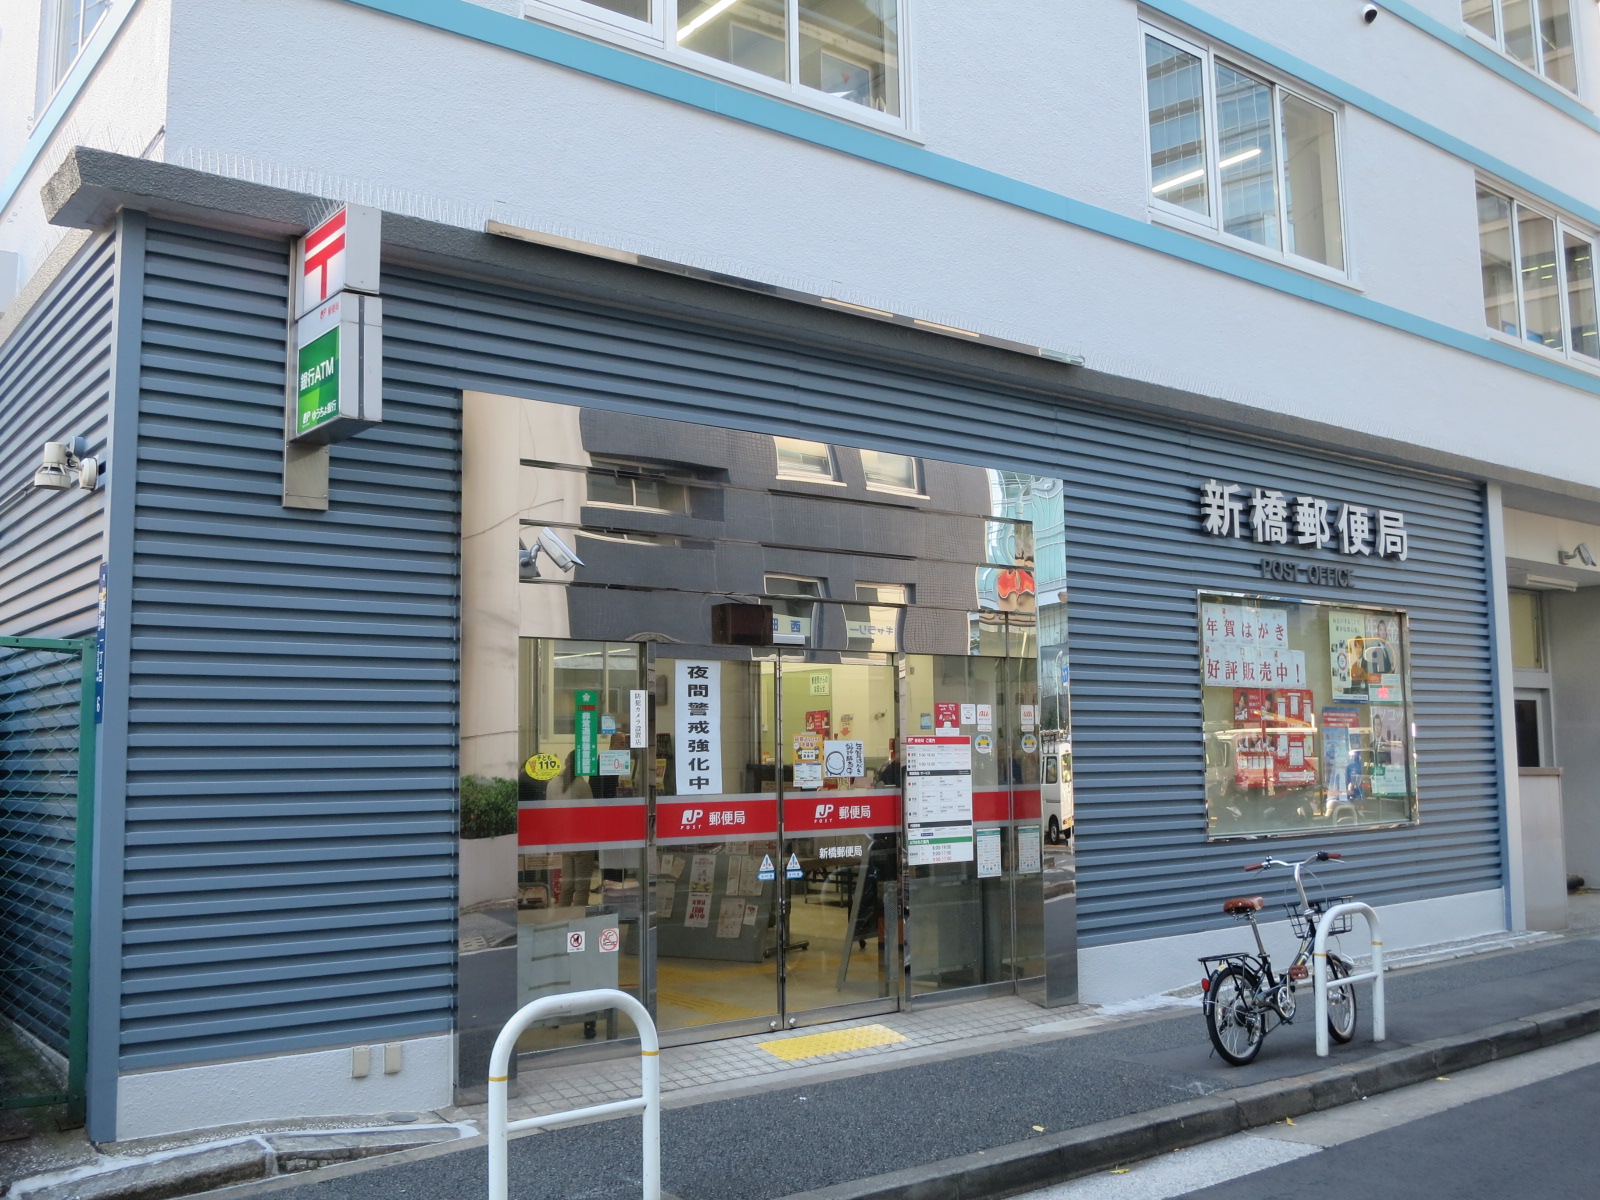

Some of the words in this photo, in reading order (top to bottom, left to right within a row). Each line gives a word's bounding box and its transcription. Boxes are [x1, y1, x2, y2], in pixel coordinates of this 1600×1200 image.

[300, 356, 334, 391] 銀行ATM
[312, 400, 337, 422] ゆうちょ銀行
[1200, 479, 1408, 562] 新橋郵便局
[1261, 558, 1300, 582] POST
[1307, 565, 1355, 588] OFFICE
[1205, 617, 1285, 642] 年賀はがき
[1207, 659, 1300, 684] 好評販売中！
[634, 692, 642, 746] 防犯カメラ設置店
[687, 665, 710, 790] 夜間警戒強化中
[682, 809, 703, 825] JP
[708, 810, 746, 826] 郵便局
[815, 804, 834, 819] JP
[839, 805, 871, 820] 郵便局
[819, 846, 863, 860] 新橋郵便局
